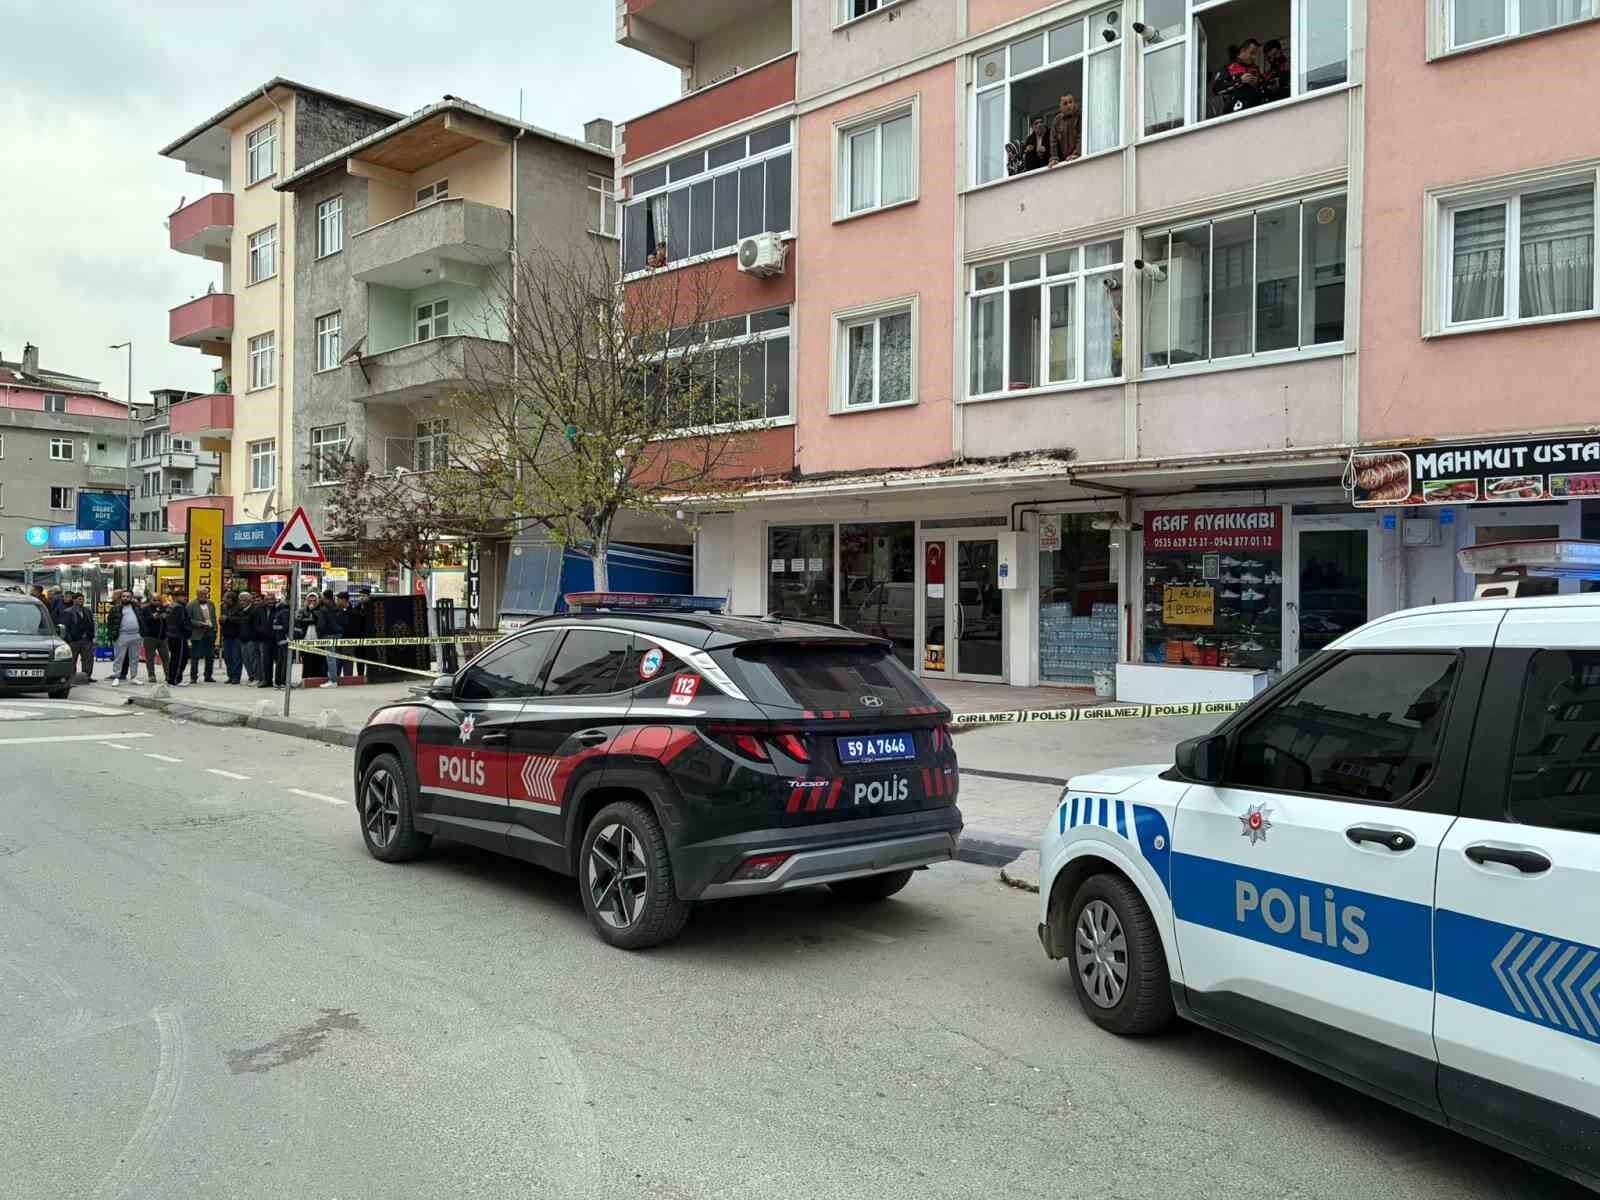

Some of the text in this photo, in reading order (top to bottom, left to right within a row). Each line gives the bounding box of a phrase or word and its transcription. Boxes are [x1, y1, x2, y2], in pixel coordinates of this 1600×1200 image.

[1415, 441, 1600, 480] MAHMUT USTA
[1152, 512, 1275, 532] ASAF AYAKKABI
[675, 677, 695, 694] 112
[848, 738, 906, 757] 59 A 7646
[439, 751, 485, 786] POLİS
[854, 774, 909, 805] POLİS
[1236, 880, 1369, 955] POLİS
